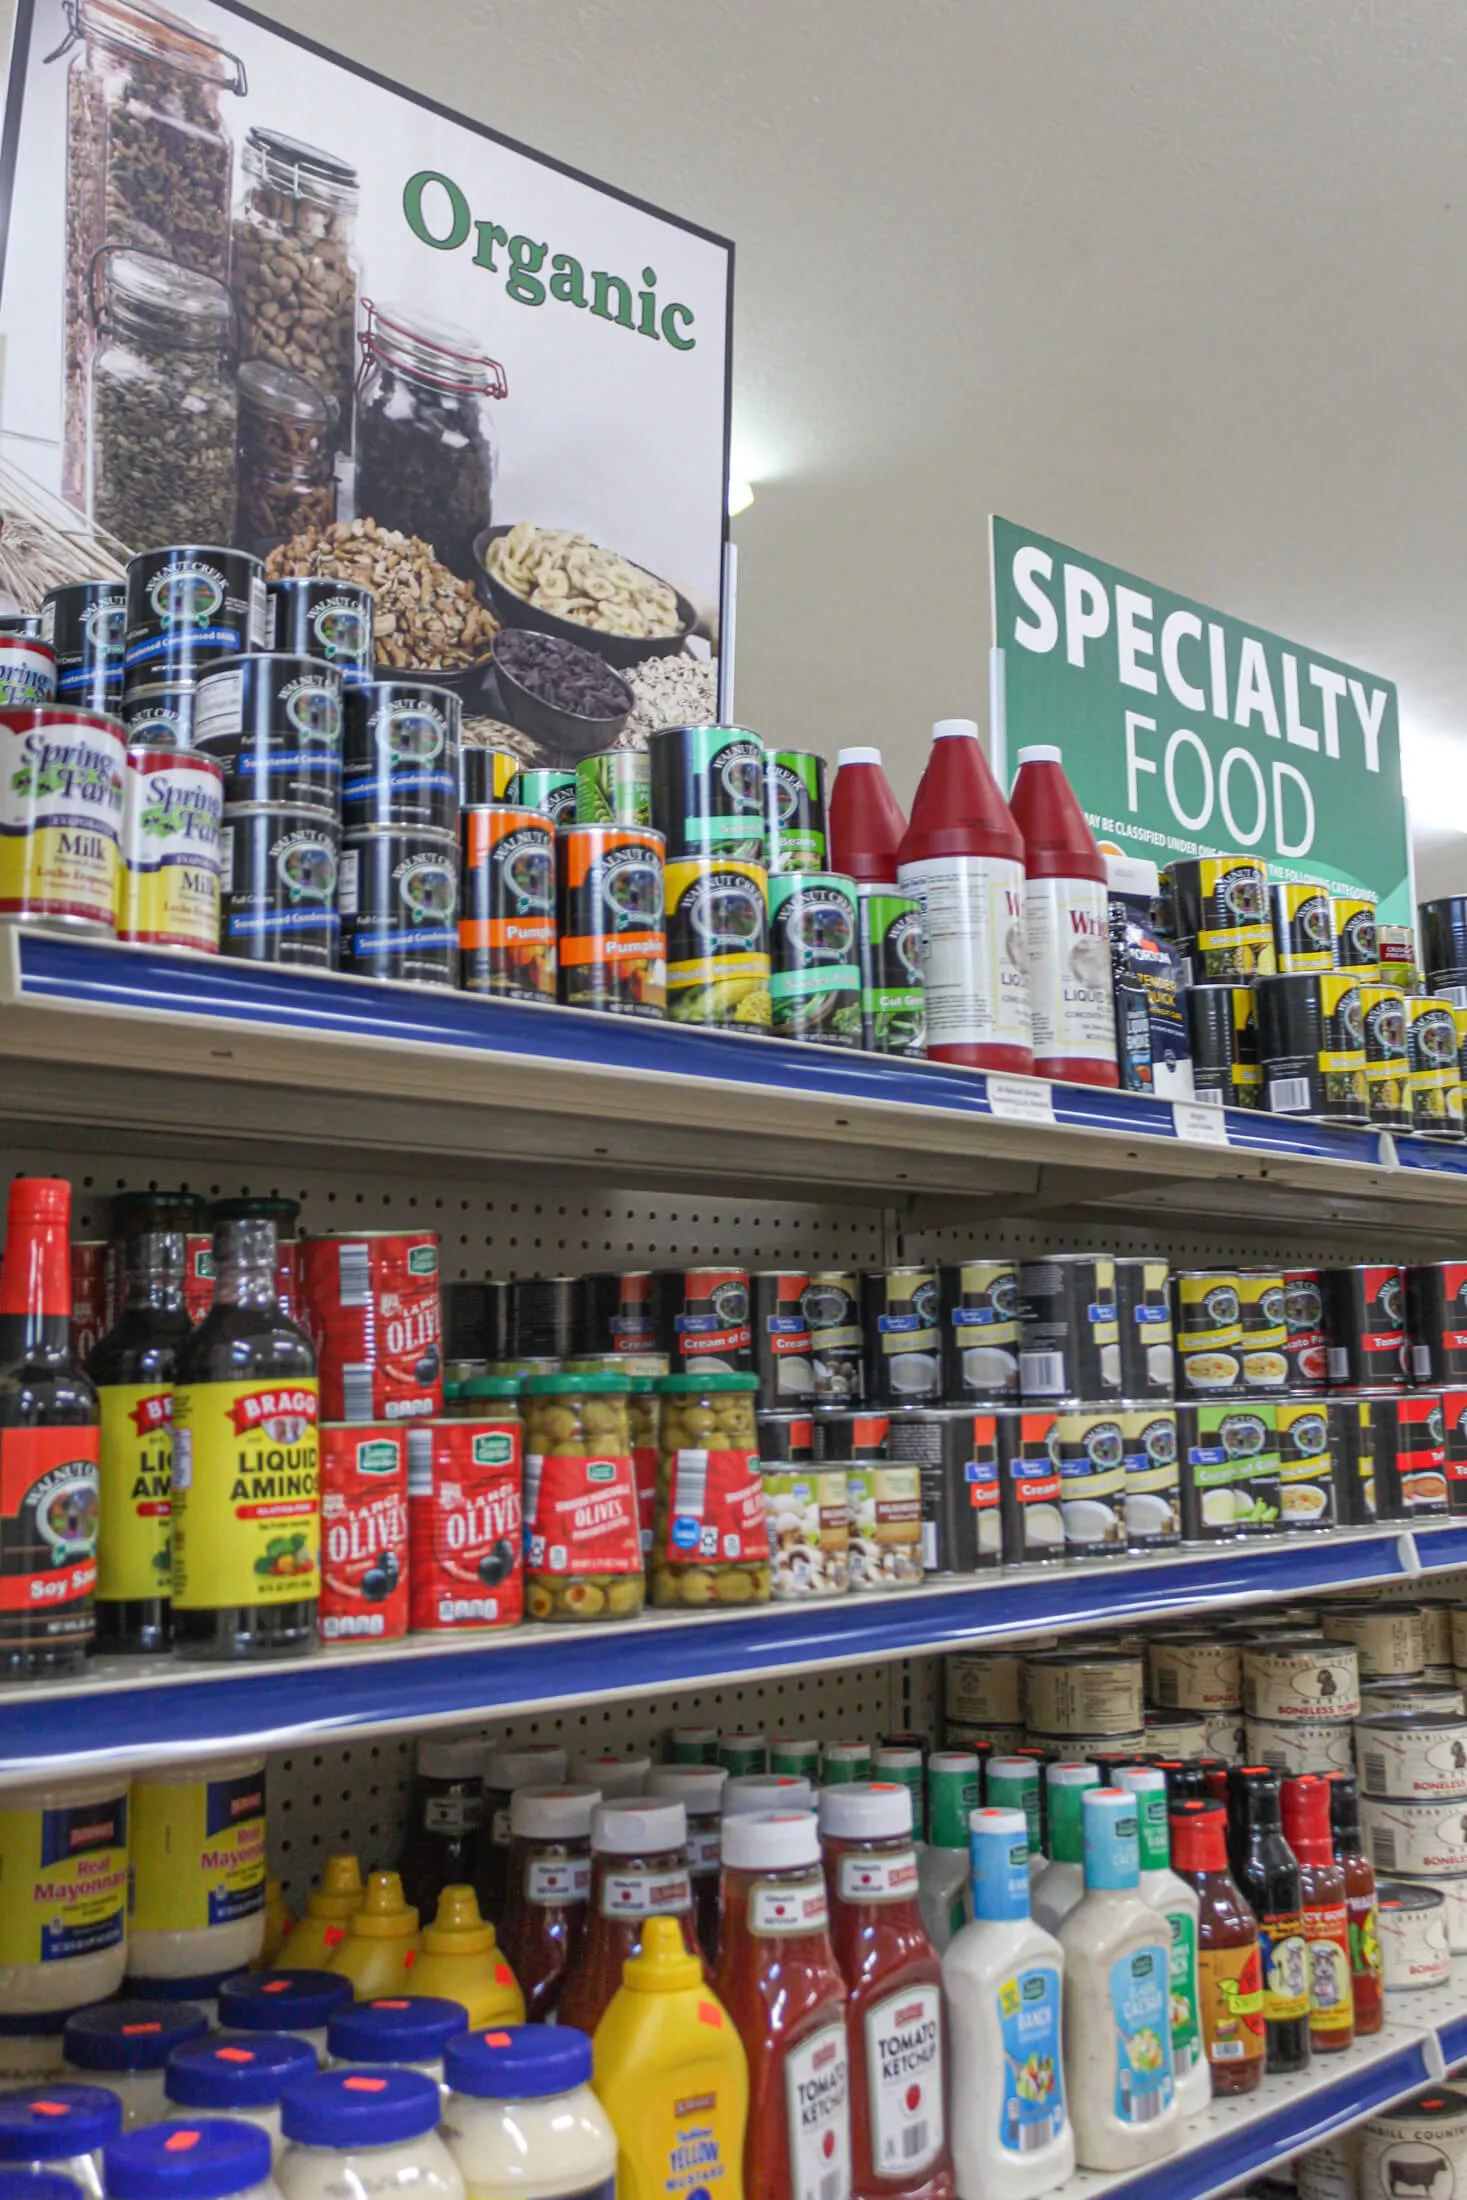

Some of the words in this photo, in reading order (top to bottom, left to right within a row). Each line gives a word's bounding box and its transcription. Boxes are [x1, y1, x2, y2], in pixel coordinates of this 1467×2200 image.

[403, 170, 696, 350] Organic
[145, 562, 190, 592] WALNUT
[190, 561, 230, 589] CREEK
[127, 639, 162, 661] weetened
[1012, 546, 1388, 773] SPECIALTY
[20, 732, 116, 780] Spring
[57, 767, 124, 812] Farm
[1124, 710, 1315, 858] FOOD
[179, 810, 221, 846] Far
[269, 829, 318, 856] WALNUT
[1102, 816, 1115, 832] BE
[1115, 818, 1167, 848] CLASSIFIED
[1167, 836, 1198, 857] UNDER
[56, 832, 107, 862] Milk
[493, 831, 544, 861] WALNUT
[391, 852, 440, 878] WALNUT
[1269, 863, 1285, 879] THE
[181, 871, 216, 897] Milk
[684, 1338, 726, 1349] Cream
[244, 1392, 317, 1418] BRAGG
[238, 1448, 317, 1474] LIQUID
[25, 1462, 86, 1506] WALNUT
[229, 1474, 317, 1501] AMINO
[574, 1500, 624, 1528] OLIVES
[30, 1580, 68, 1599] Soy
[72, 1568, 97, 1590] Sau
[1277, 1704, 1335, 1716] BONELESS
[1412, 1779, 1467, 1791] BONELESS
[236, 1826, 261, 1846] Real
[77, 1856, 111, 1878] Real
[877, 2021, 937, 2060] TOMATO
[882, 2042, 936, 2080] KETCHUP
[669, 2140, 719, 2173] YELLOW
[664, 2164, 725, 2192] MUSTARD
